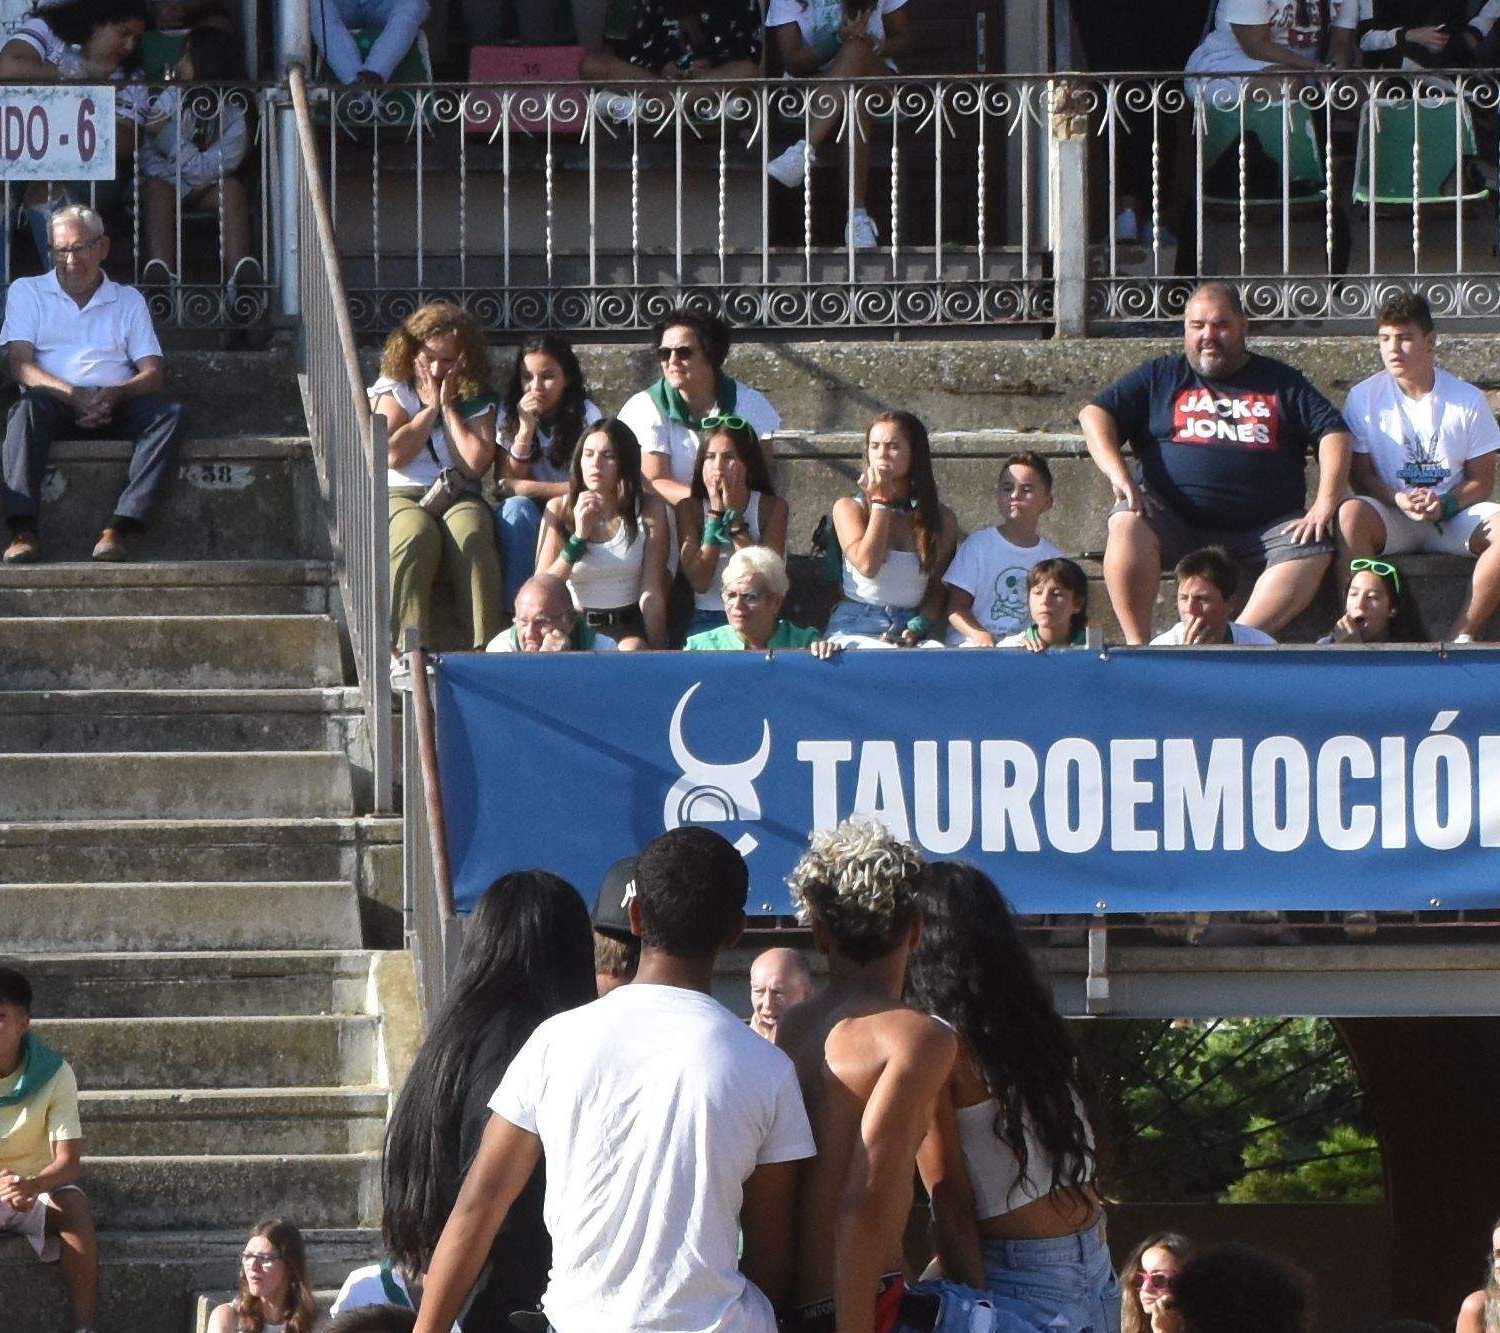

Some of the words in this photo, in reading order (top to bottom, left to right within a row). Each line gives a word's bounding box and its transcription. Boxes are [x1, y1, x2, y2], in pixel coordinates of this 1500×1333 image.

[77, 97, 97, 161] 6
[1179, 416, 1271, 444] JONES
[797, 709, 1500, 854] TAUROEMOCIÓ
